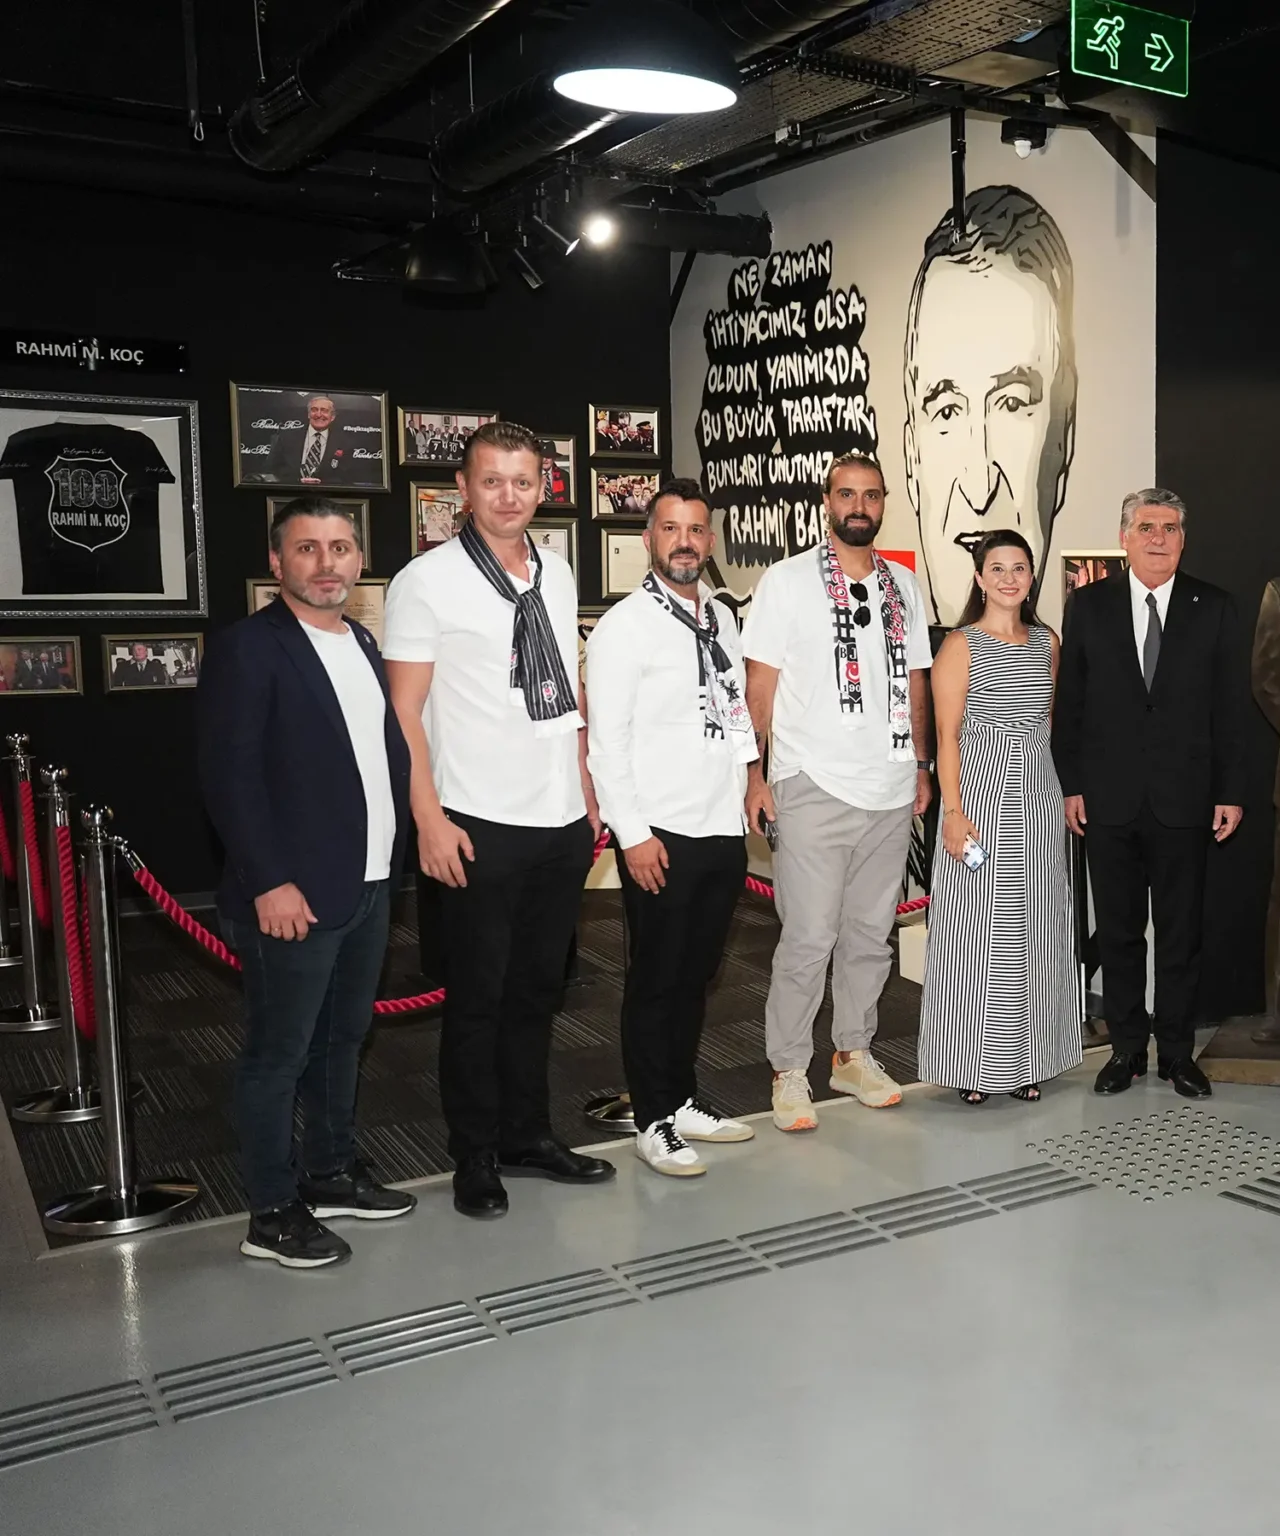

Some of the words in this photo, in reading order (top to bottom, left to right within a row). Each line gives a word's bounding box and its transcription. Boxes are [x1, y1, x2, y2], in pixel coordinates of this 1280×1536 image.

[734, 263, 759, 299] NE
[772, 246, 831, 287] ZAMAN
[814, 291, 865, 332] OLSA
[16, 341, 77, 358] RAHMİ
[82, 346, 105, 360] M.
[110, 348, 144, 366] KOÇ
[766, 345, 867, 393] YANIMIZDA
[702, 409, 721, 447] BU
[724, 402, 776, 443] BÜYÜK
[54, 468, 119, 508] 100
[53, 510, 87, 527] RAHMİ
[90, 513, 102, 527] M.
[105, 514, 127, 531] KOÇ
[730, 499, 785, 547] RAHMİ
